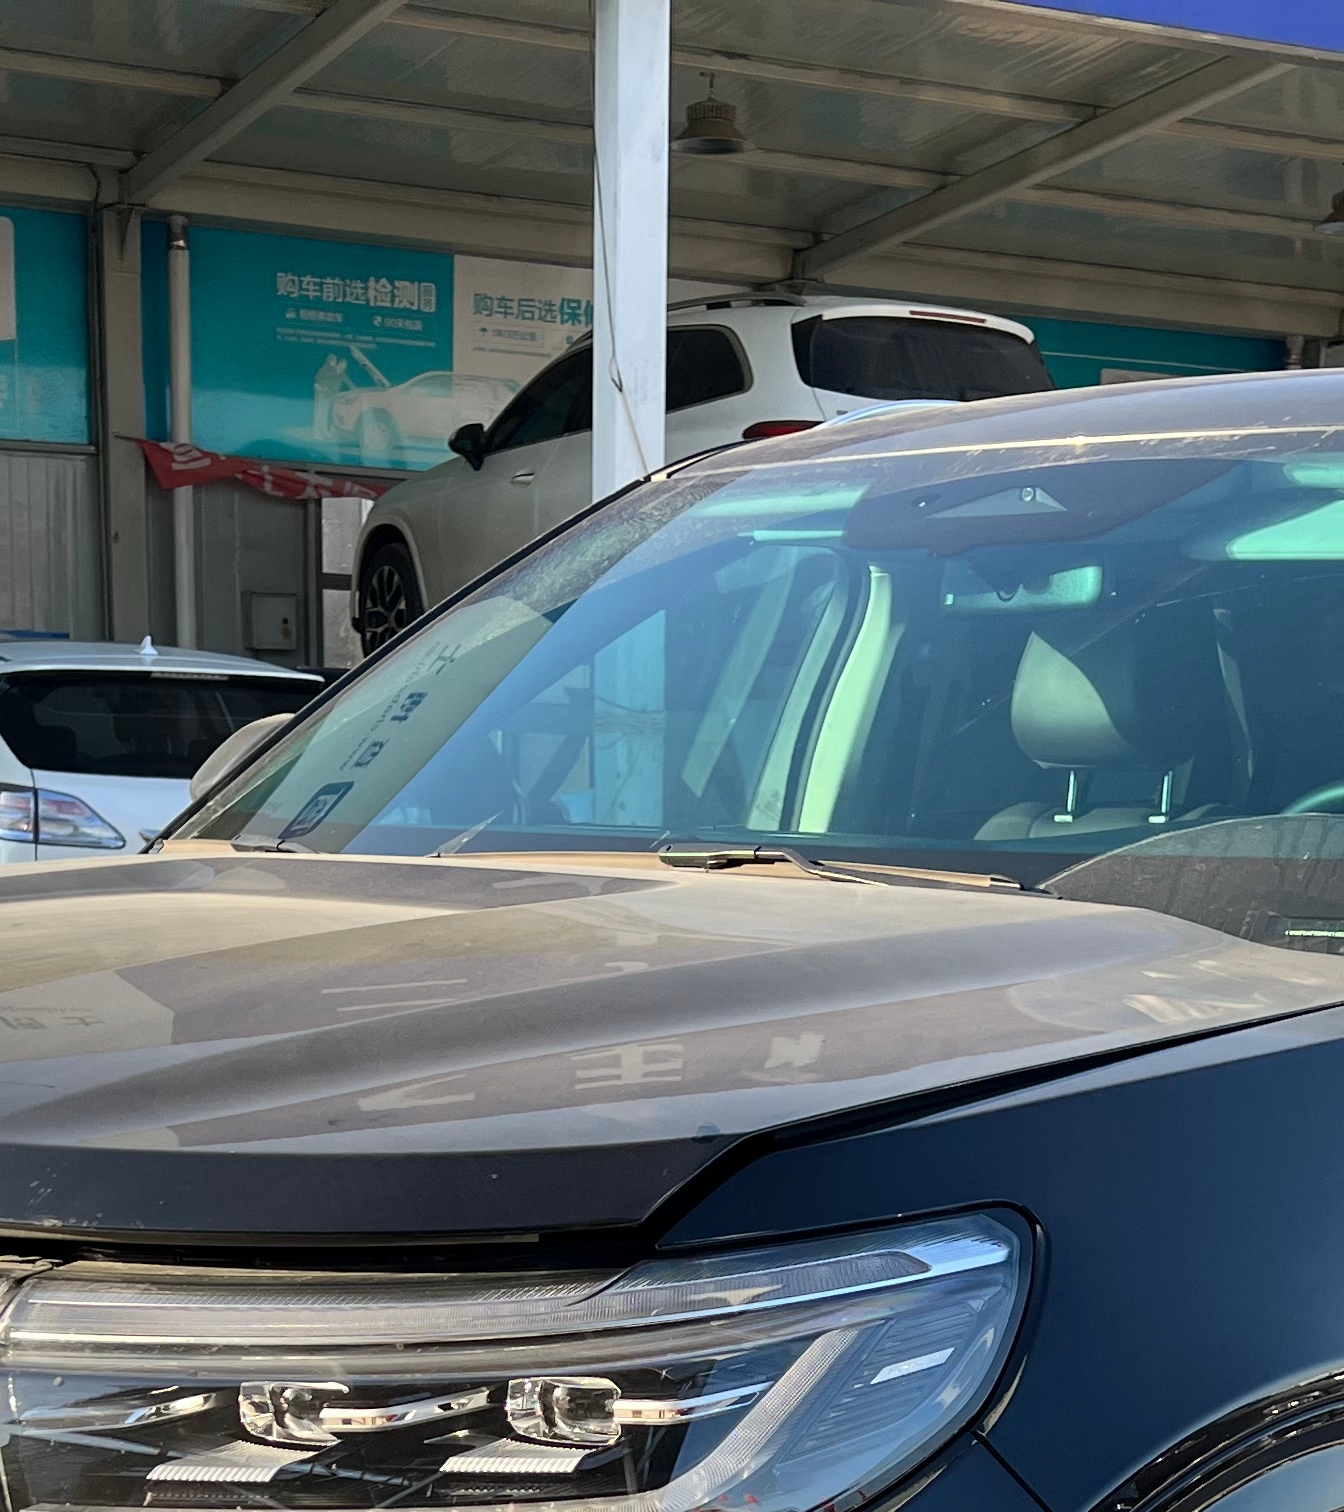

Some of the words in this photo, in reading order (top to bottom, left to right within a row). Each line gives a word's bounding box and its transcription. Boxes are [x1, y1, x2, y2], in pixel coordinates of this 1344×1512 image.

[276, 271, 419, 311] 购车前选检测
